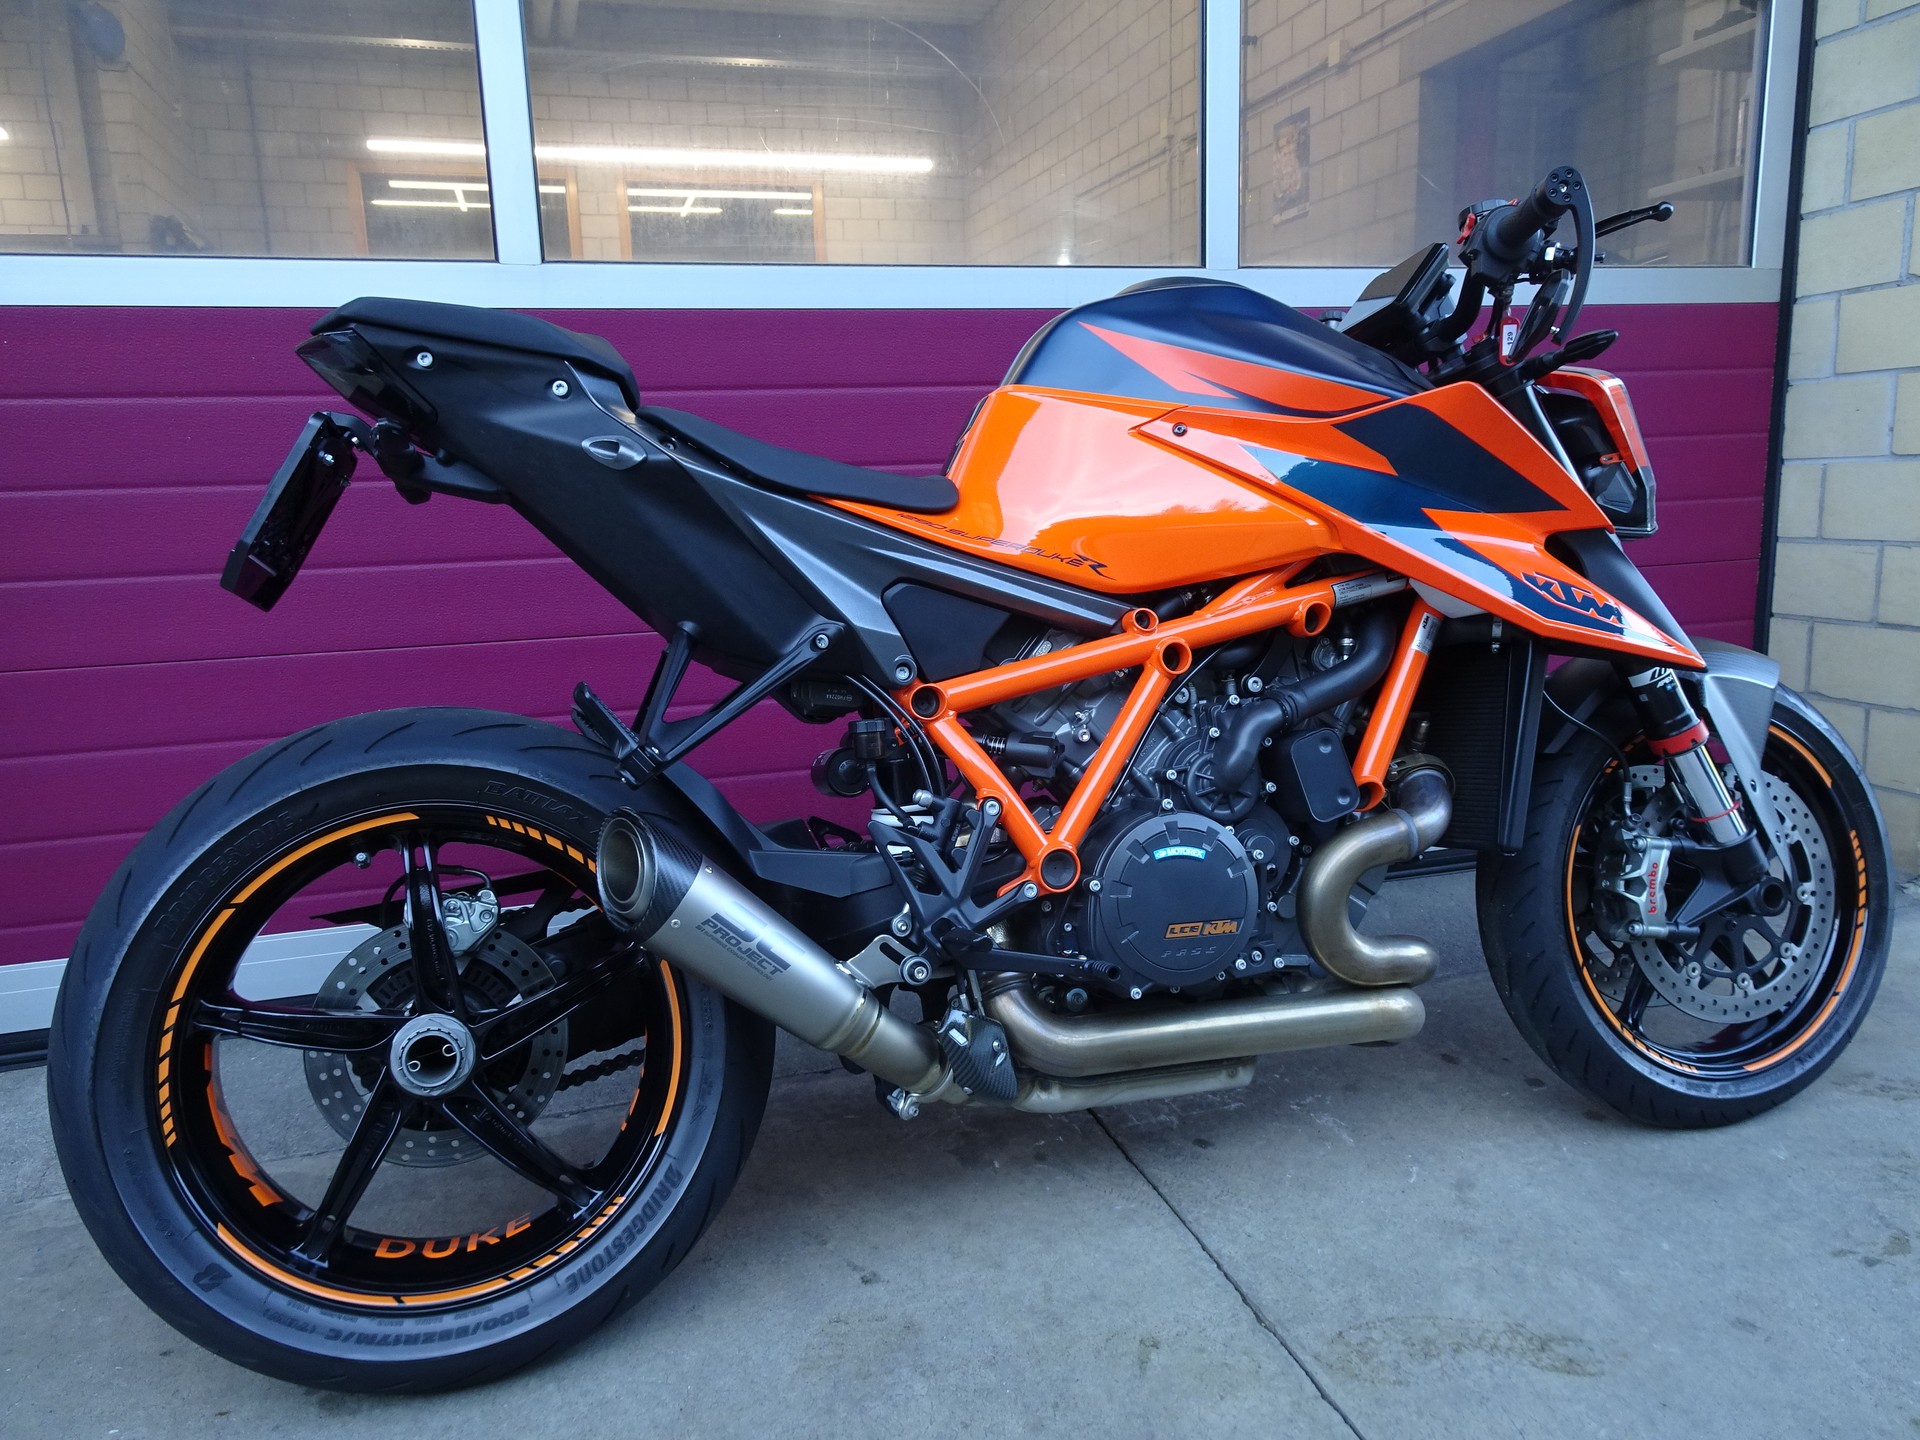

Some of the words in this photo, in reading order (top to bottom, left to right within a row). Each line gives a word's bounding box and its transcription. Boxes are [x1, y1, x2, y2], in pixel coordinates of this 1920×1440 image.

[1520, 571, 1632, 628] KTM
[1647, 862, 1659, 915] brembo
[700, 918, 783, 976] PROJECT
[1202, 920, 1238, 936] KTM
[374, 1211, 532, 1259] DUKE
[563, 1163, 684, 1295] BRIDGESTONE
